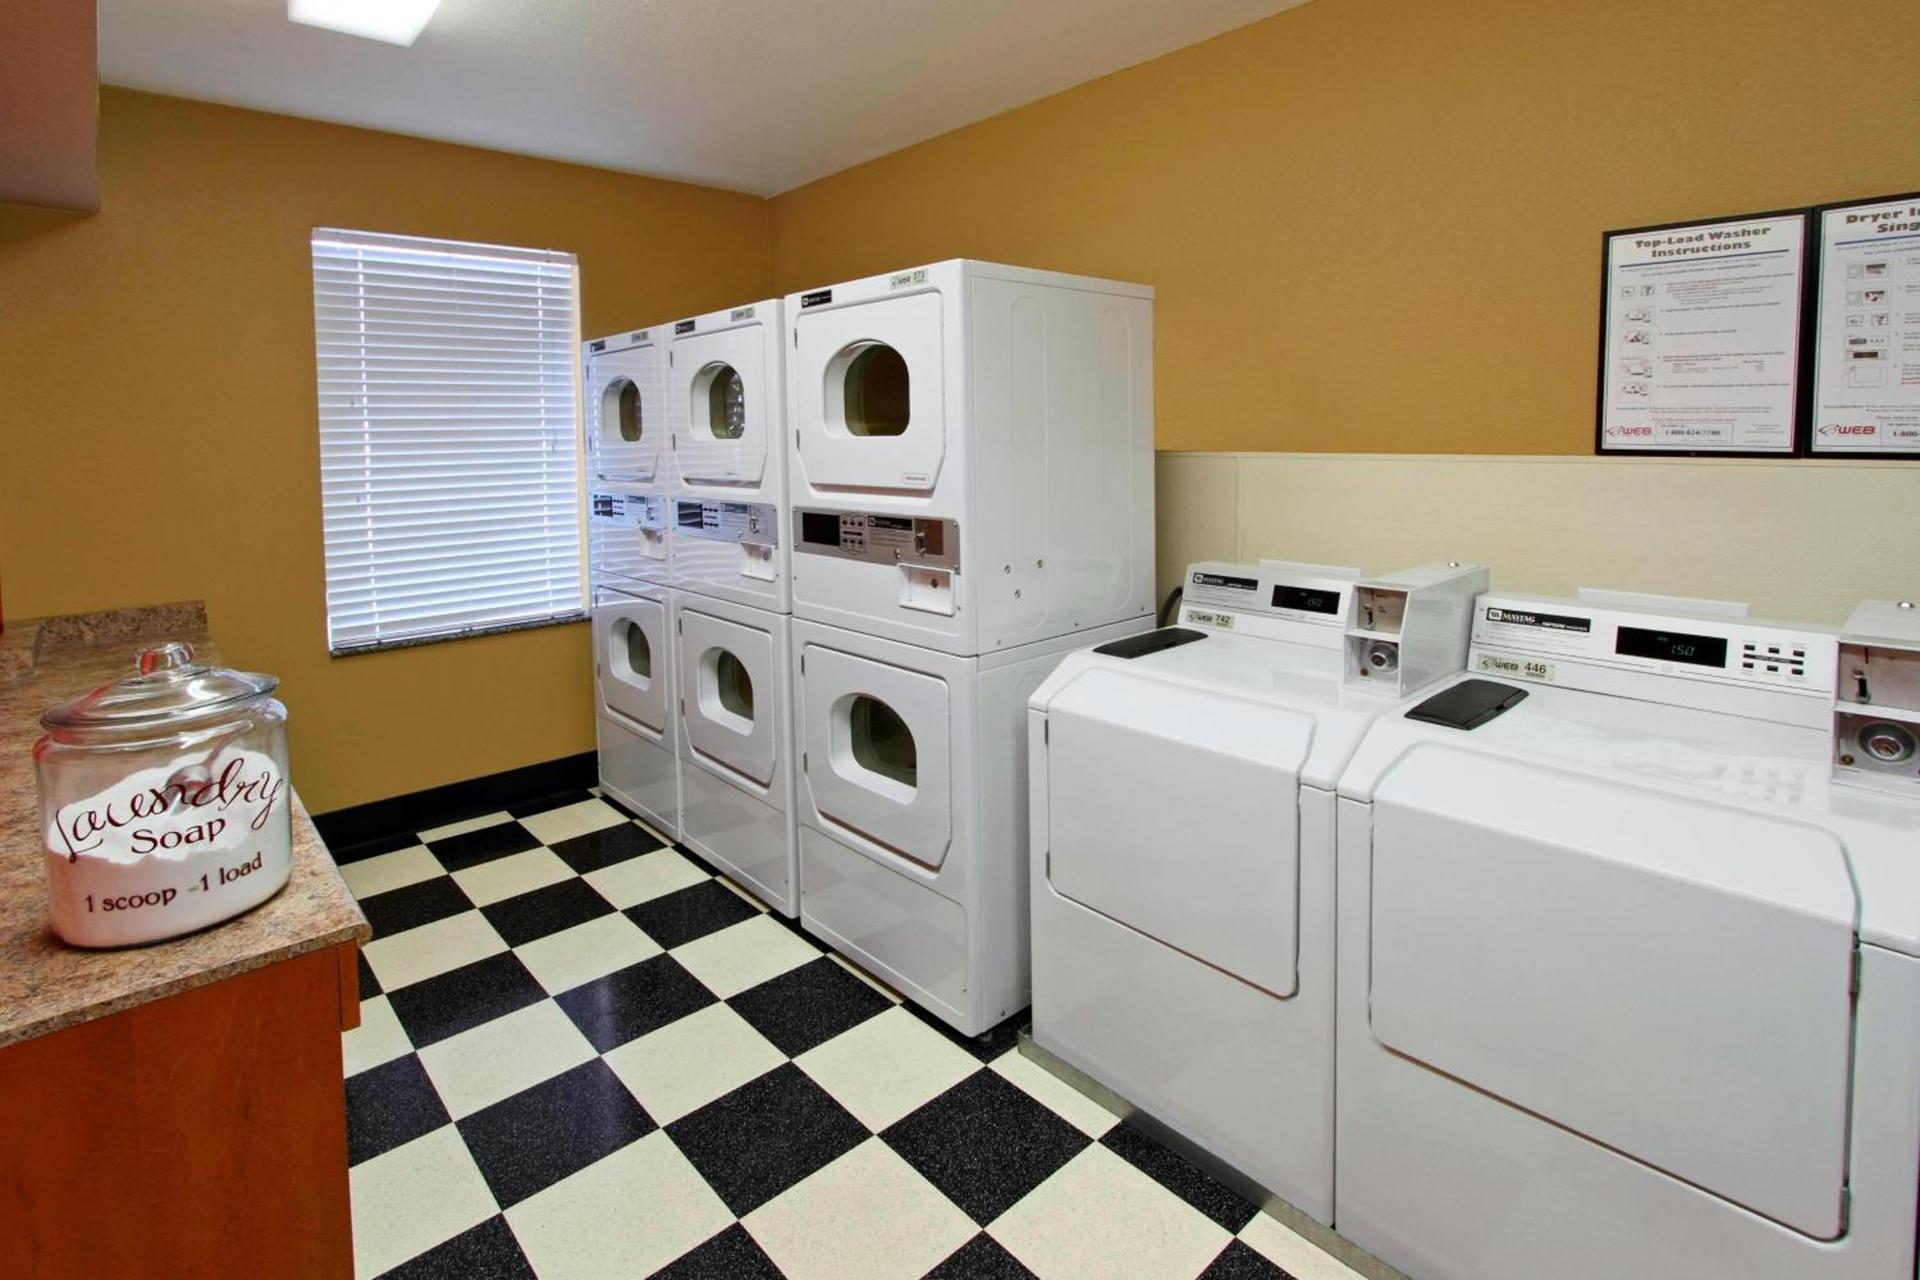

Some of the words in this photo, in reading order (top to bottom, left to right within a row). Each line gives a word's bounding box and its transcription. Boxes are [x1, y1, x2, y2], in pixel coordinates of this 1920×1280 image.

[1845, 210, 1903, 224] Dryer
[1635, 233, 1704, 249] Top-Load
[1709, 226, 1771, 240] Washer
[1652, 239, 1752, 258] Instructions
[1622, 426, 1652, 436] WEB
[1838, 425, 1876, 435] WEB
[1495, 659, 1519, 671] WEB
[1524, 661, 1547, 674] 446
[56, 758, 283, 863] Laundry
[131, 817, 226, 855] Soap
[85, 895, 94, 913] 1
[103, 885, 177, 912] scoop
[200, 873, 209, 892] 1
[219, 851, 263, 885] load
